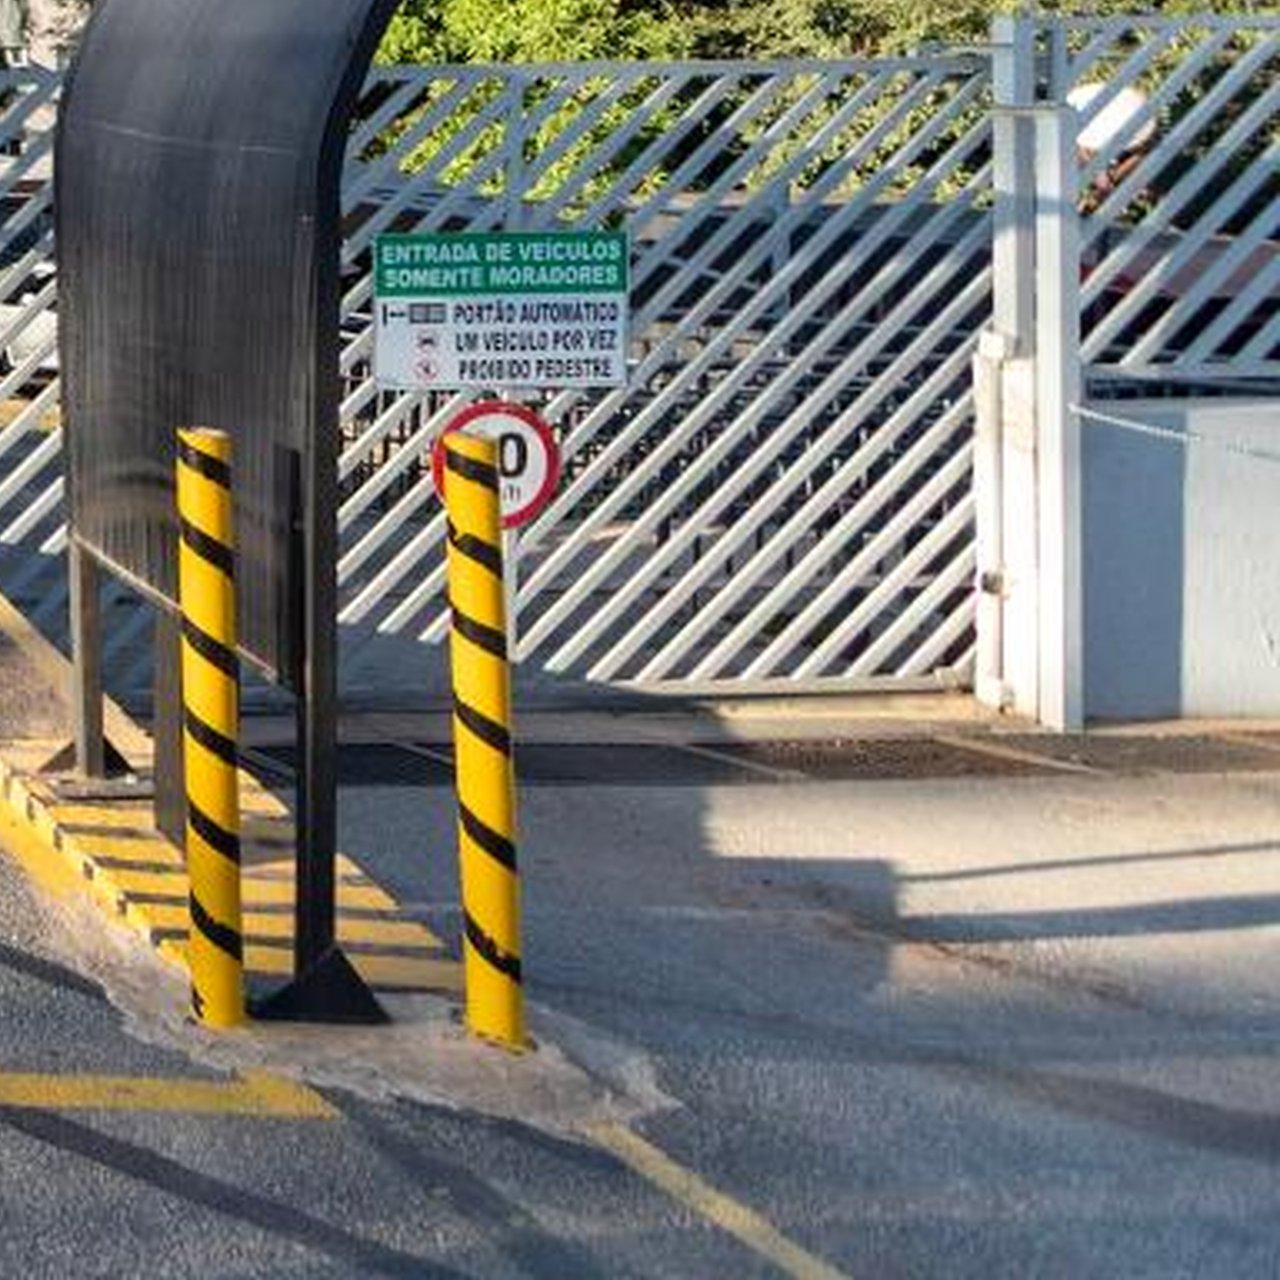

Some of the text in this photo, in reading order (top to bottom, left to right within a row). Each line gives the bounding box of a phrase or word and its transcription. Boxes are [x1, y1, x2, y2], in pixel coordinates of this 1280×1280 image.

[382, 238, 621, 264] ENTRADA DE VEÍCULOS
[385, 266, 618, 288] SOMENTE MORADORES
[453, 300, 619, 324] PORTÃO AUTOMÁTICO
[553, 331, 585, 350] POR
[590, 329, 617, 350] VEZ
[460, 357, 612, 380] PROIBIDO PEDESTRE
[498, 432, 528, 478] 0
